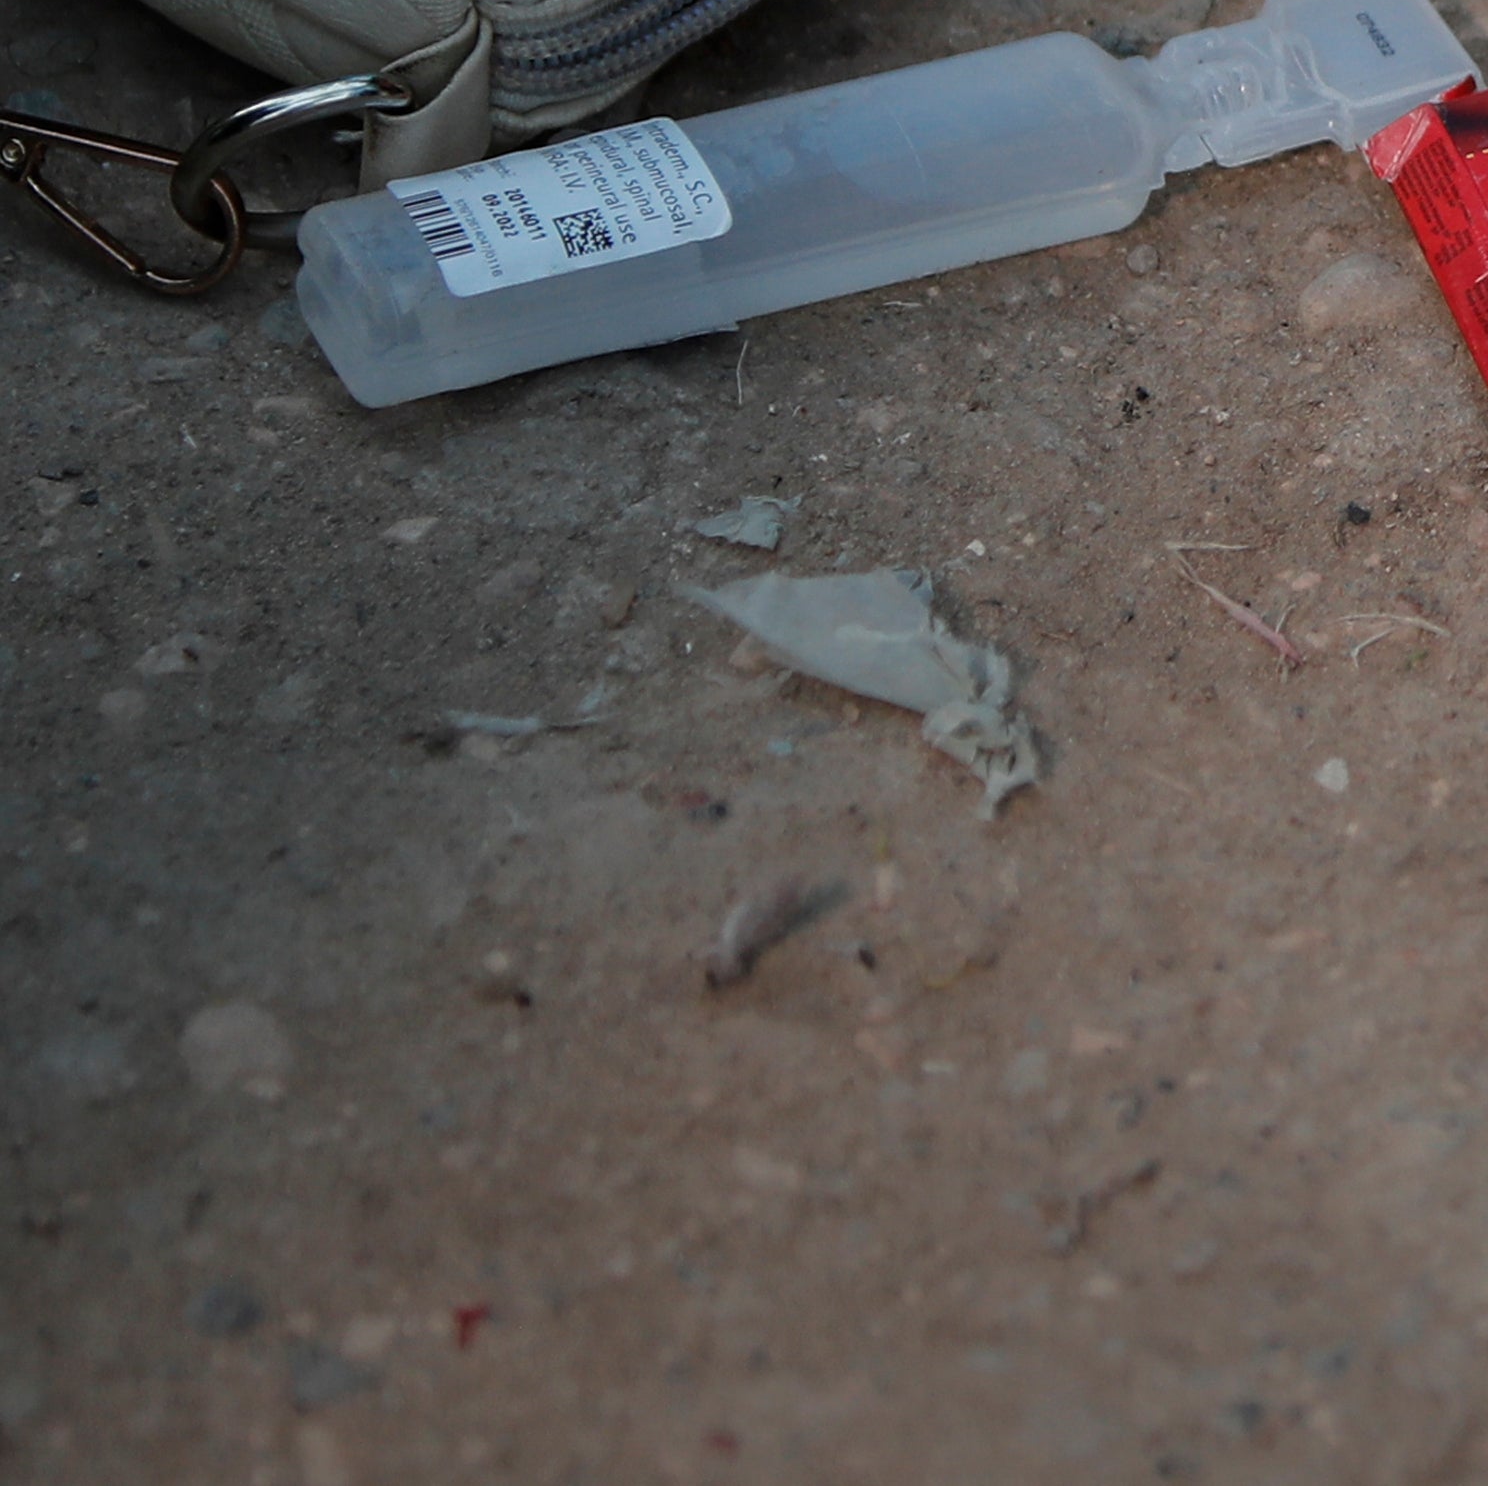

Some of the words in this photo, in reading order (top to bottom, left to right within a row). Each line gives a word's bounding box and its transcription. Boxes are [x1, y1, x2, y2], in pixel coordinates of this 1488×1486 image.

[481, 192, 519, 239] 09.2022
[503, 187, 547, 242] 20146011
[567, 150, 625, 211] perineural
[614, 214, 636, 246] use
[621, 178, 661, 221] spinal
[631, 146, 693, 235] submucosal,
[683, 178, 713, 216] S.C.,
